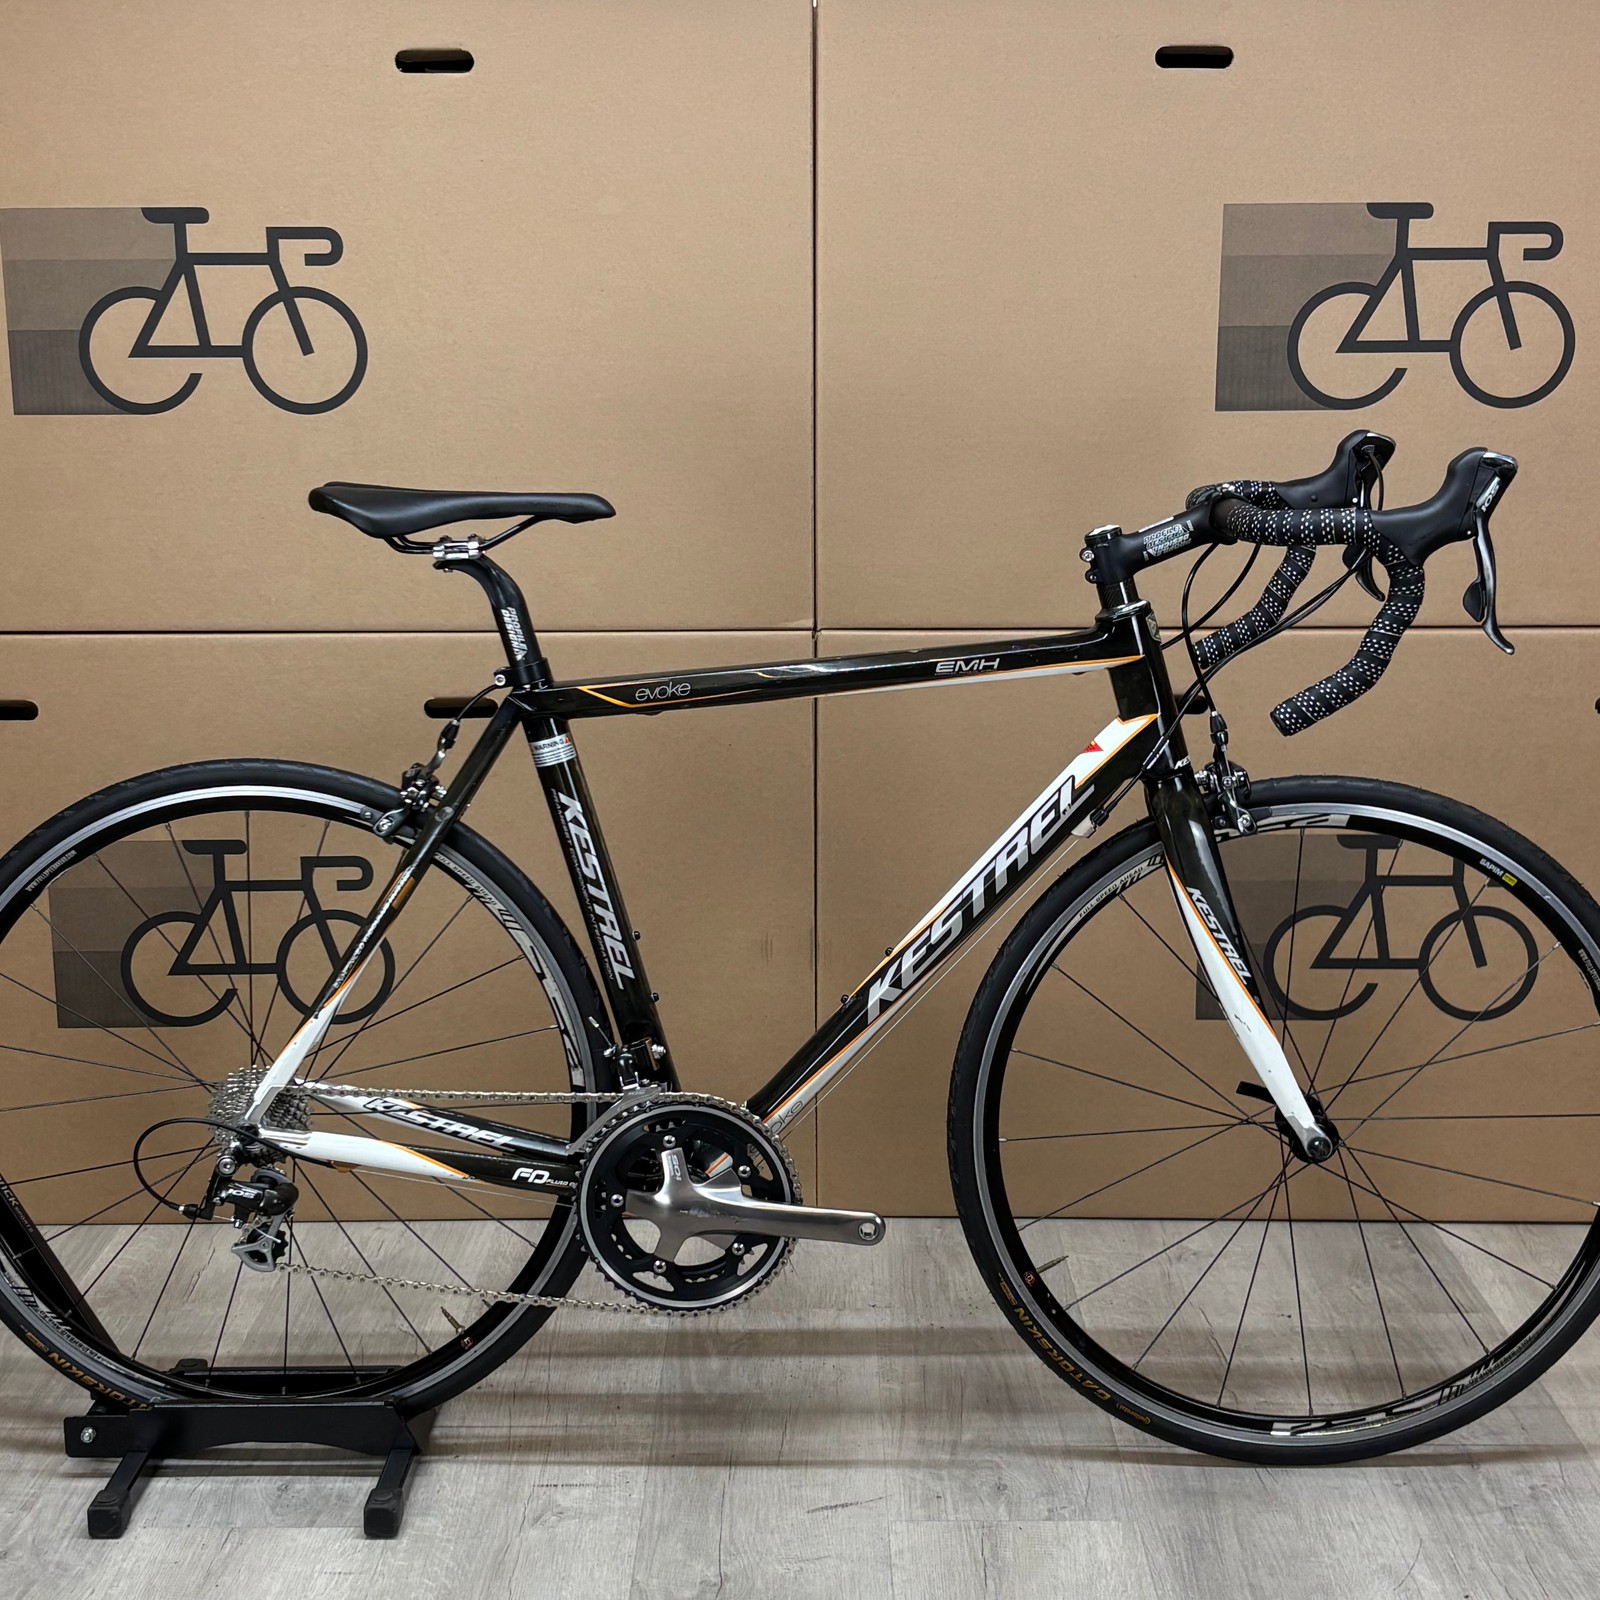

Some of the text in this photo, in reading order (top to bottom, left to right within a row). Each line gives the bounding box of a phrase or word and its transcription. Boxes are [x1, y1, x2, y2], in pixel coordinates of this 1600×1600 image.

[635, 681, 691, 702] evoke
[935, 658, 1000, 674] EMH
[557, 791, 635, 990] KESTREL
[1096, 883, 1117, 903] SPEED
[1479, 858, 1504, 877] SAPIM
[867, 774, 1095, 1026] KESTREL
[1186, 886, 1252, 985] KESTREL
[48, 1352, 149, 1409] TORSKIN
[1014, 1307, 1112, 1400] GATORSKIN
